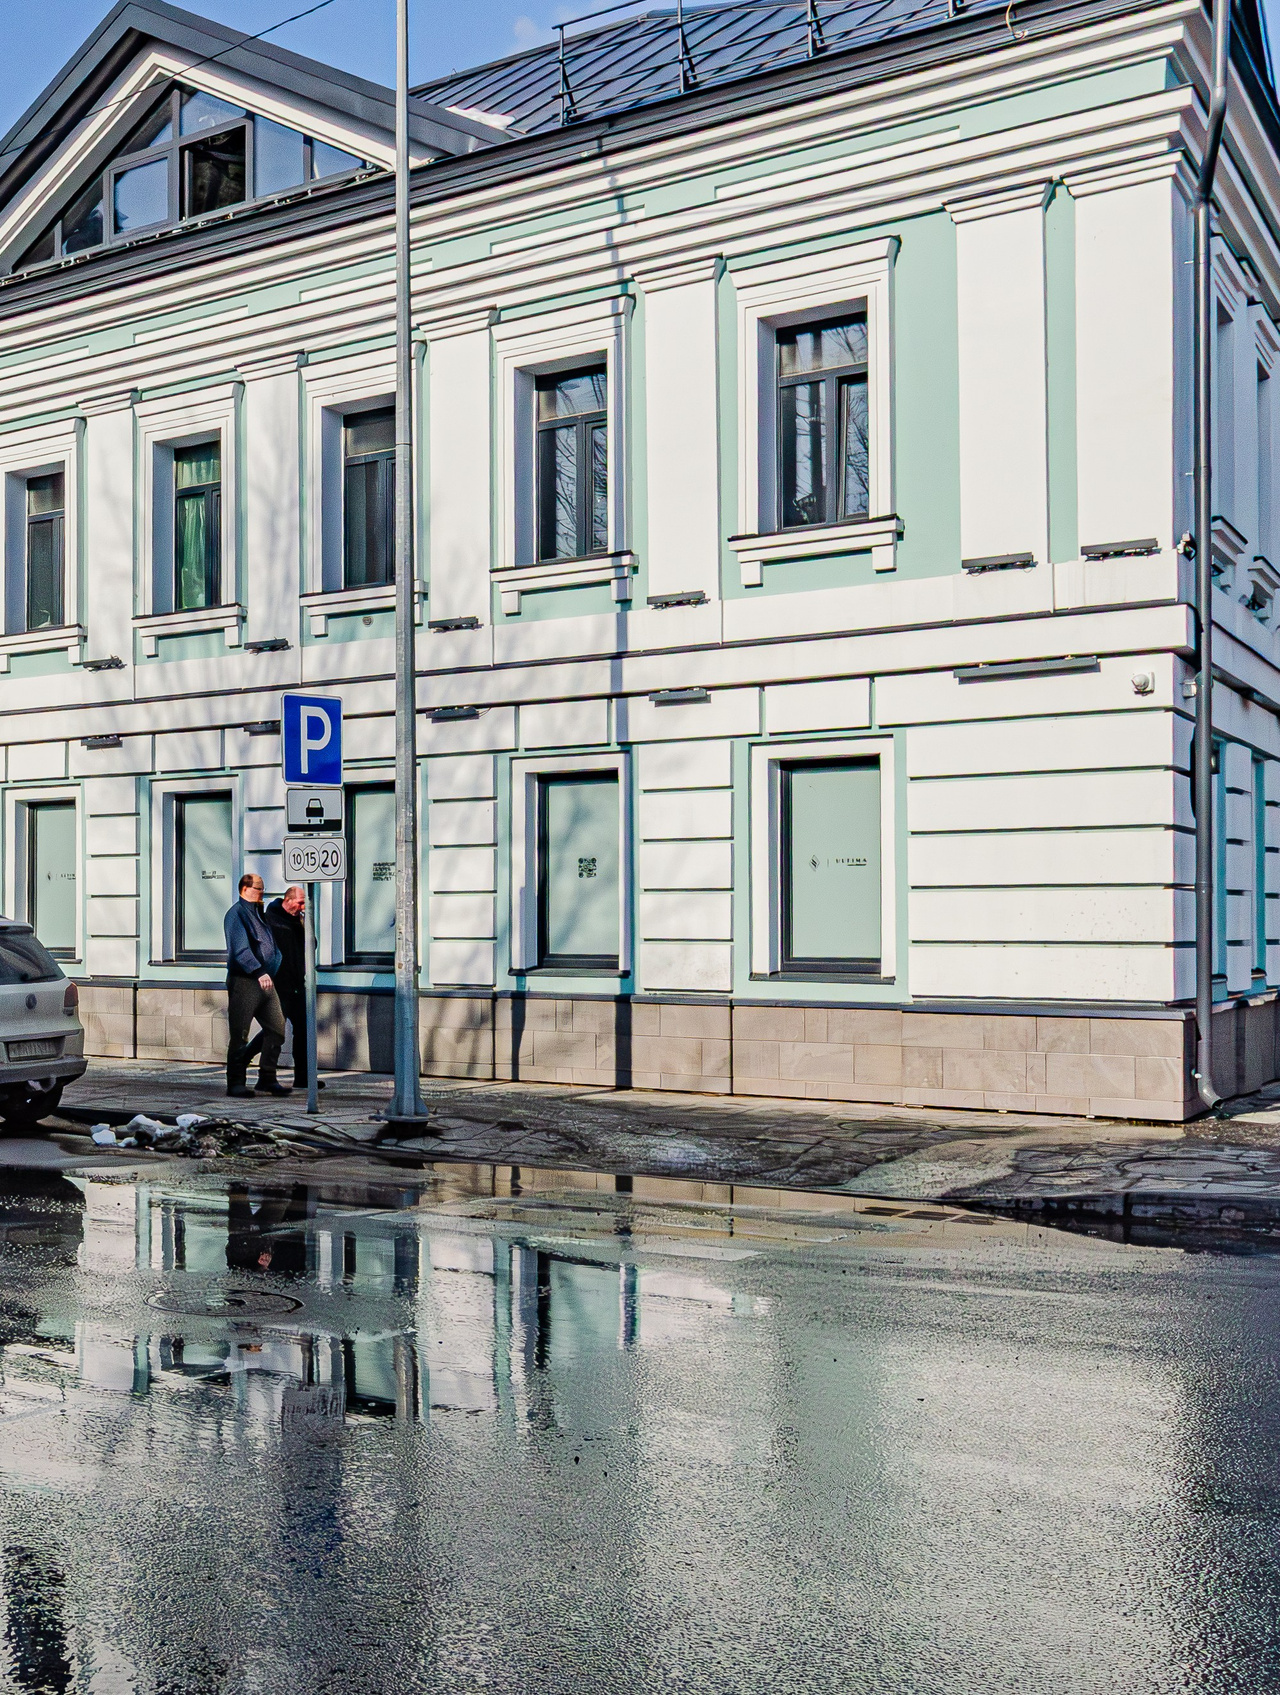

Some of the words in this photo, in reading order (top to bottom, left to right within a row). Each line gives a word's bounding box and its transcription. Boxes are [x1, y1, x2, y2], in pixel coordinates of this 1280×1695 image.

[300, 705, 332, 775] P
[292, 853, 302, 866] 10
[305, 851, 317, 867] 15
[321, 850, 339, 868] 20
